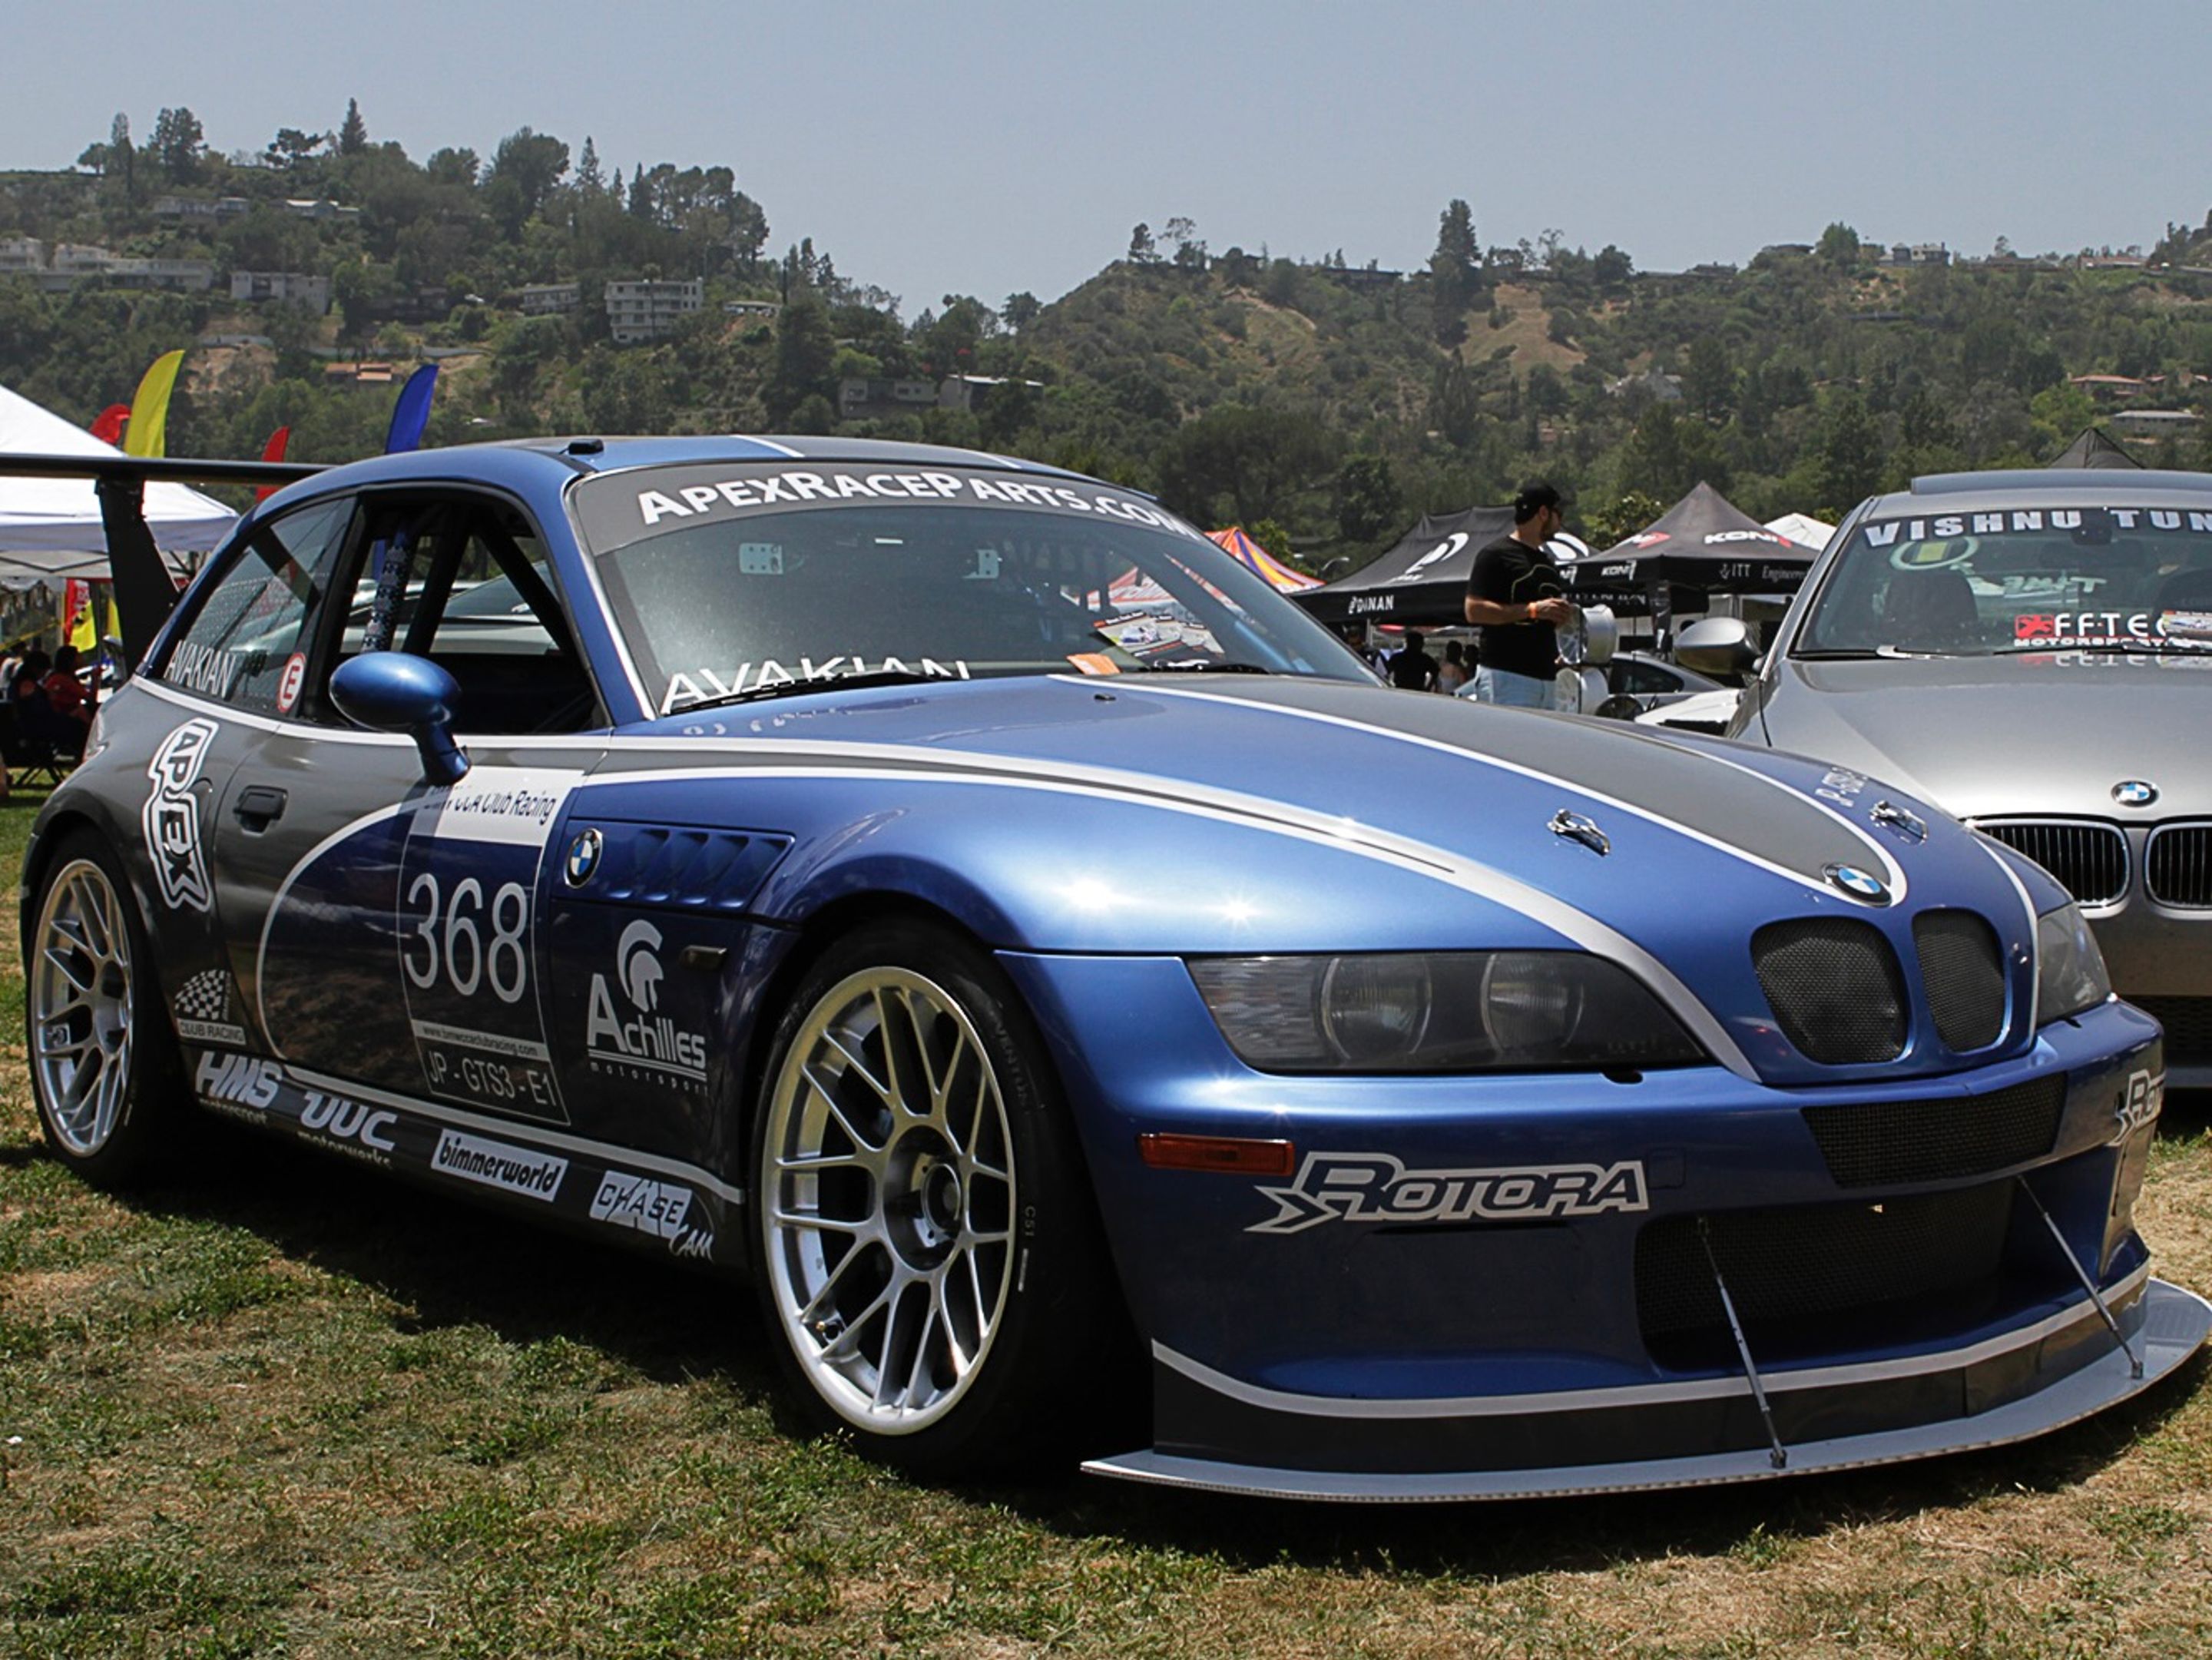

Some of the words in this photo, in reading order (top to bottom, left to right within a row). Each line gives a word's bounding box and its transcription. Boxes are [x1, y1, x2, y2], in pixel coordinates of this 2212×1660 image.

[1865, 510, 2081, 547] VISHNU
[1732, 563, 1750, 578] ITT
[1356, 595, 1395, 614] DINAN
[164, 640, 236, 698] AVAKIAN
[283, 665, 300, 701] E
[150, 724, 212, 900] APEX
[511, 790, 557, 826] Racing
[404, 873, 528, 1003] 368
[180, 1021, 205, 1037] CLUB
[208, 1023, 245, 1042] RACING
[587, 972, 706, 1069] Achilles
[196, 1051, 283, 1108] HMS
[439, 1135, 561, 1195] bimmerworld
[597, 1183, 684, 1225] CHASE
[1284, 1153, 1648, 1223] ROTORA
[667, 1224, 715, 1263] CAM
